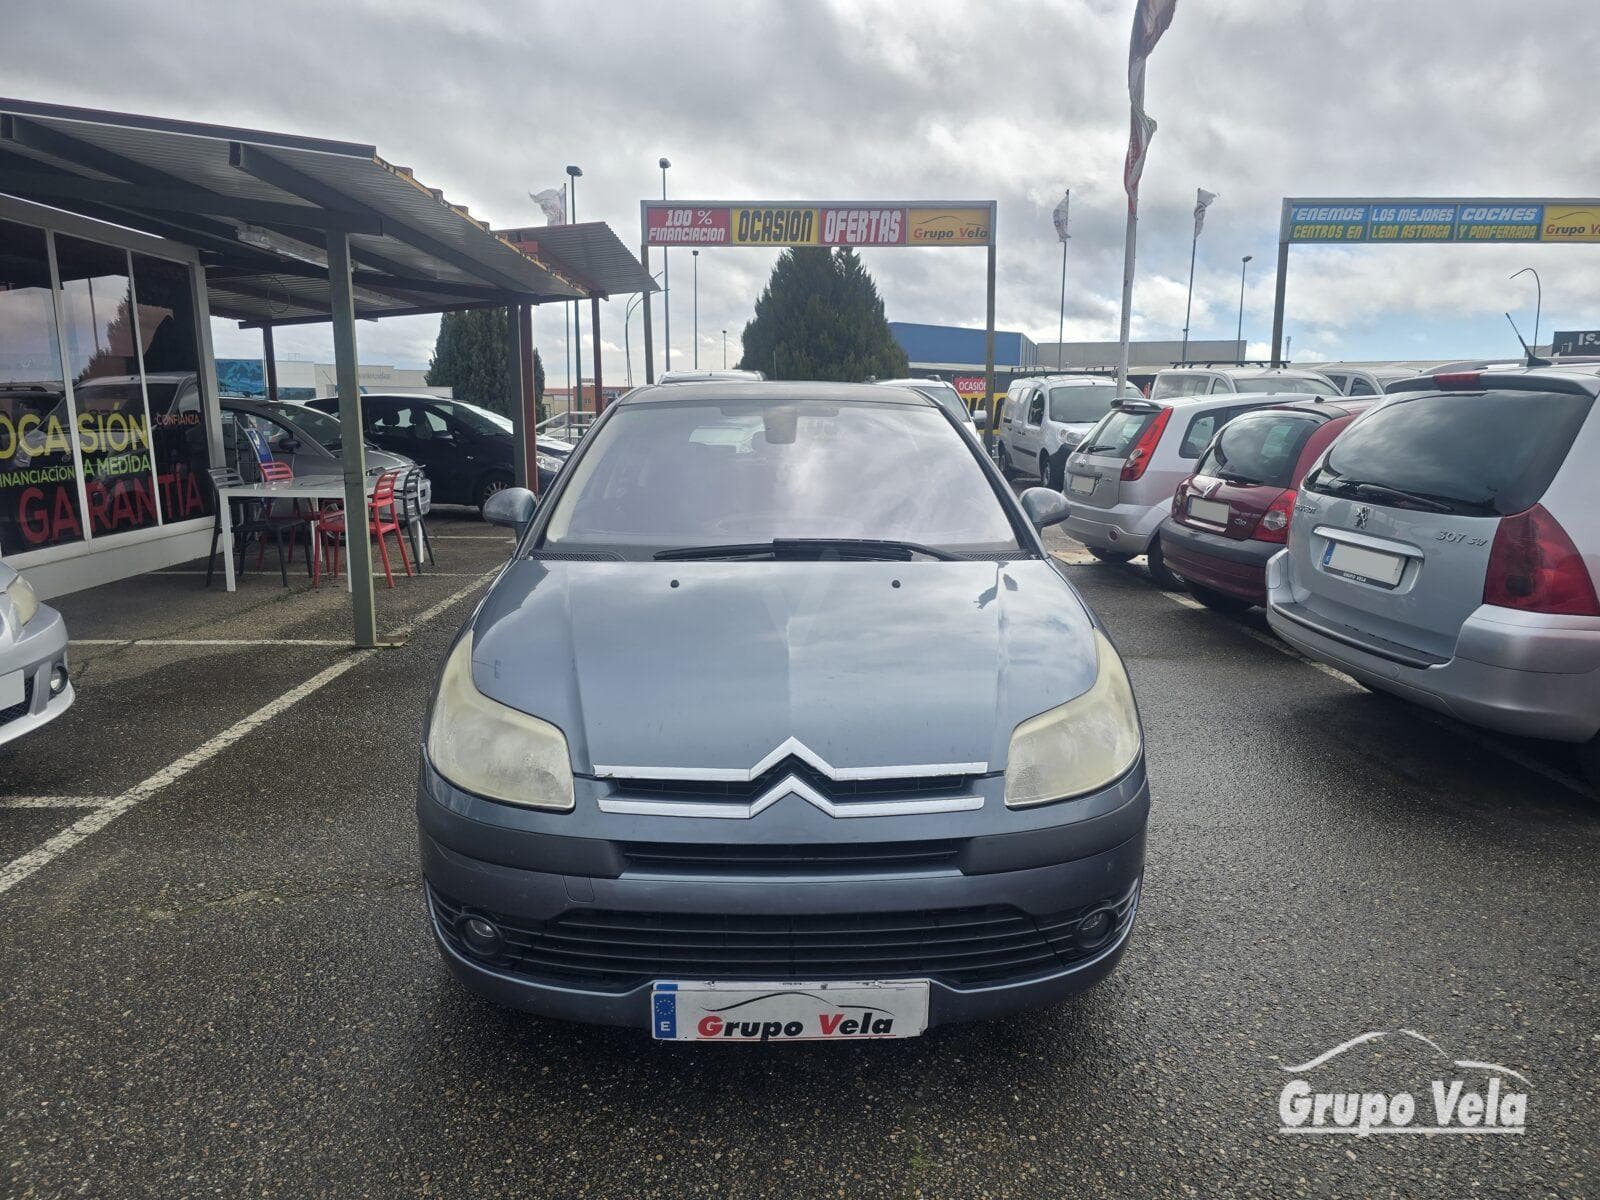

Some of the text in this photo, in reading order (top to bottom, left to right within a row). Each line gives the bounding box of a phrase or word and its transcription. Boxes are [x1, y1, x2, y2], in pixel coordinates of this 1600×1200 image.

[666, 210, 713, 226] 100 %
[1372, 208, 1455, 222] LOS MEJORES
[1462, 208, 1538, 221] COCHES
[738, 210, 813, 242] OCASION
[824, 210, 901, 243] OFERTAS
[1294, 225, 1344, 239] CENTROS
[1400, 225, 1450, 238] ASTORGA
[1458, 225, 1468, 239] Y
[1546, 223, 1586, 236] Grupo
[649, 227, 726, 242] FINANCIACION
[913, 227, 989, 240] Grupo Vela
[156, 413, 200, 426] CONFIANZA
[0, 402, 150, 459] OCASIÓN
[83, 458, 95, 477] A
[97, 454, 152, 477] MEDIDA
[19, 462, 205, 544] GARANTÍA
[660, 1021, 670, 1032] E
[697, 1012, 893, 1041] Grupo Vela
